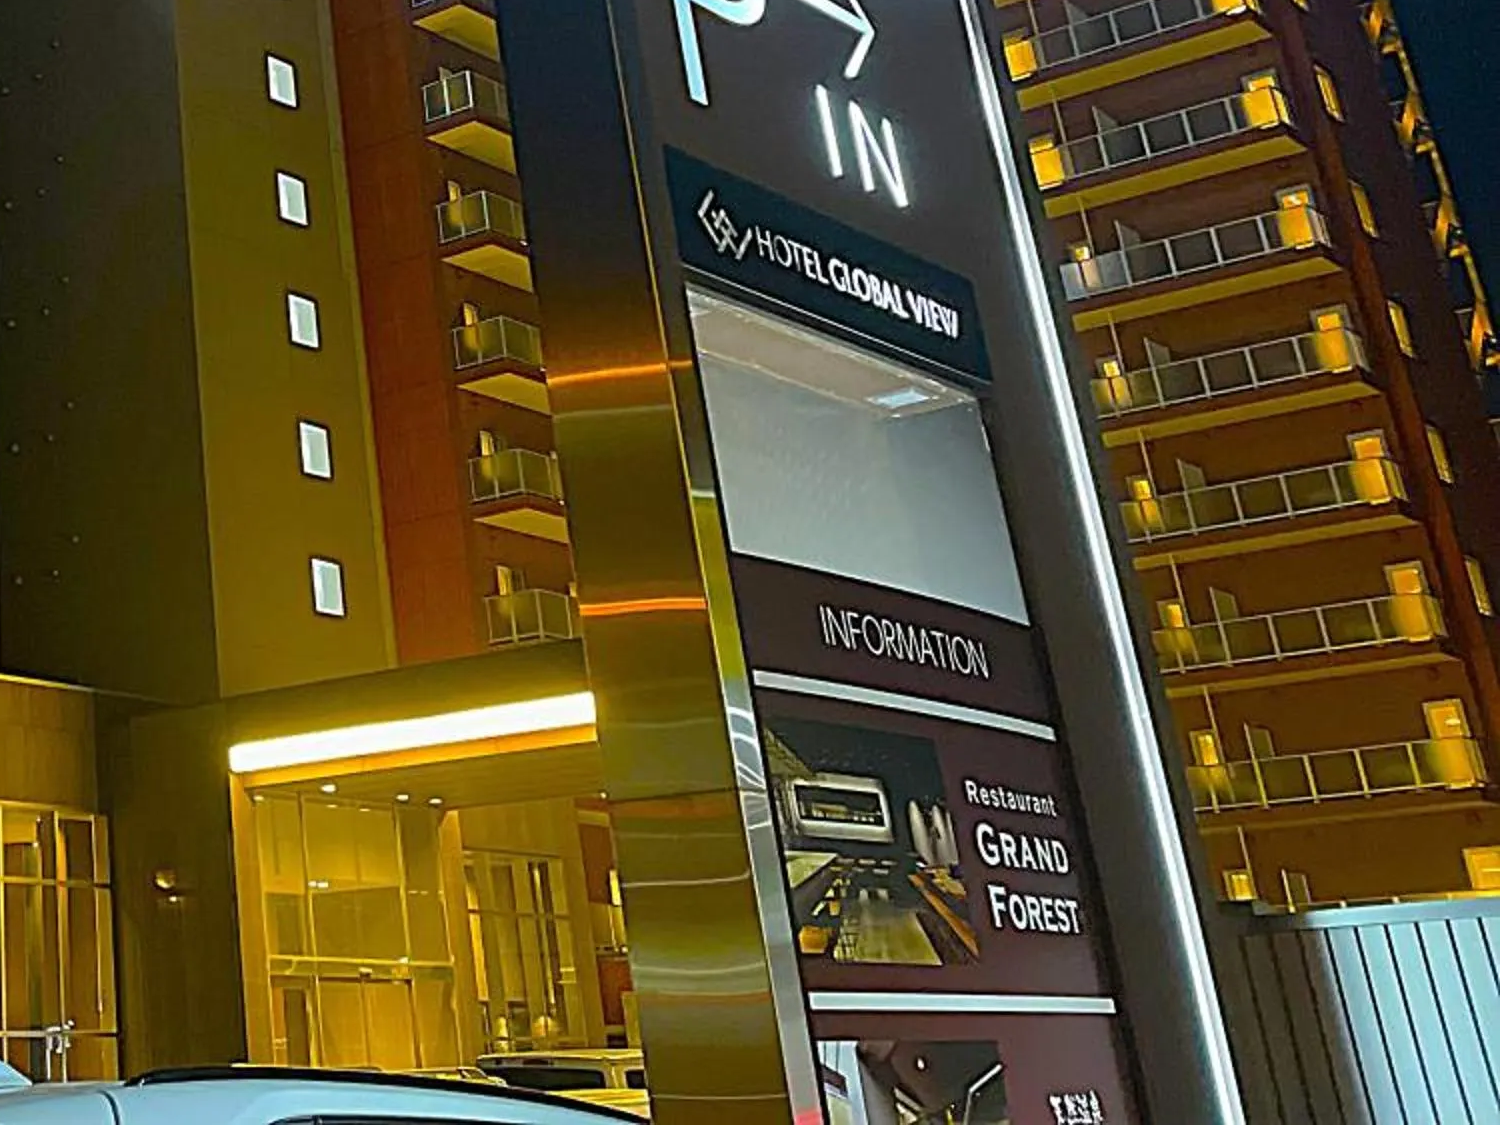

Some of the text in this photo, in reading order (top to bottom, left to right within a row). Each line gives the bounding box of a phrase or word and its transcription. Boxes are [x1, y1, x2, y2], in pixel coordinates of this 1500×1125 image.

[815, 83, 910, 208] IN
[755, 226, 959, 339] HOTEL GLOBAL VIEW
[819, 604, 990, 679] INFORMATION
[964, 779, 1058, 818] Restaurant
[976, 822, 1069, 874] GRAND
[987, 884, 1080, 934] FOREST
